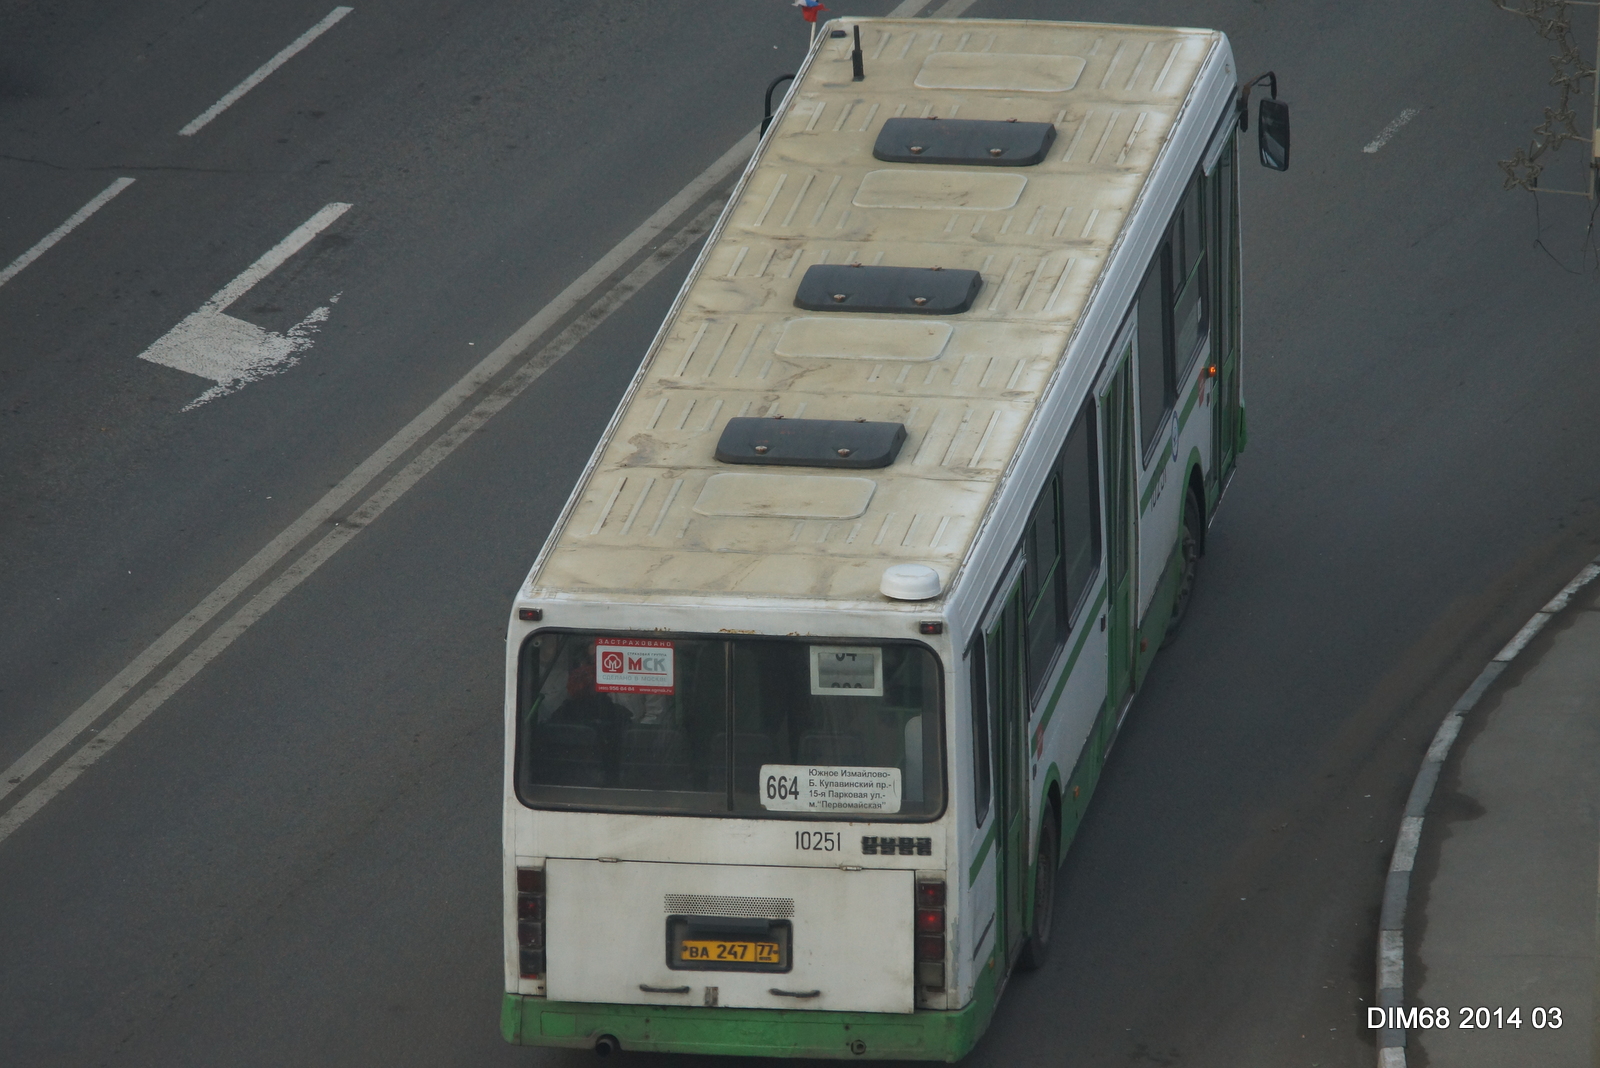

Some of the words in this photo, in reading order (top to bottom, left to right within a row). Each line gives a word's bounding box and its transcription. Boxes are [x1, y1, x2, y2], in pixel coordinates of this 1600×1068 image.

[598, 639, 671, 647] ЗАСТРАХОВАНО
[628, 657, 665, 672] МСК
[808, 768, 839, 777] Южное
[840, 769, 891, 779] Измайлово-
[766, 775, 799, 800] 664
[808, 778, 818, 787] Б.
[819, 779, 874, 789] Купавинский
[808, 790, 826, 798] 15-я
[828, 790, 868, 799] Парковая
[795, 830, 841, 852] 10251
[716, 944, 749, 960] 247
[757, 944, 774, 956] 77
